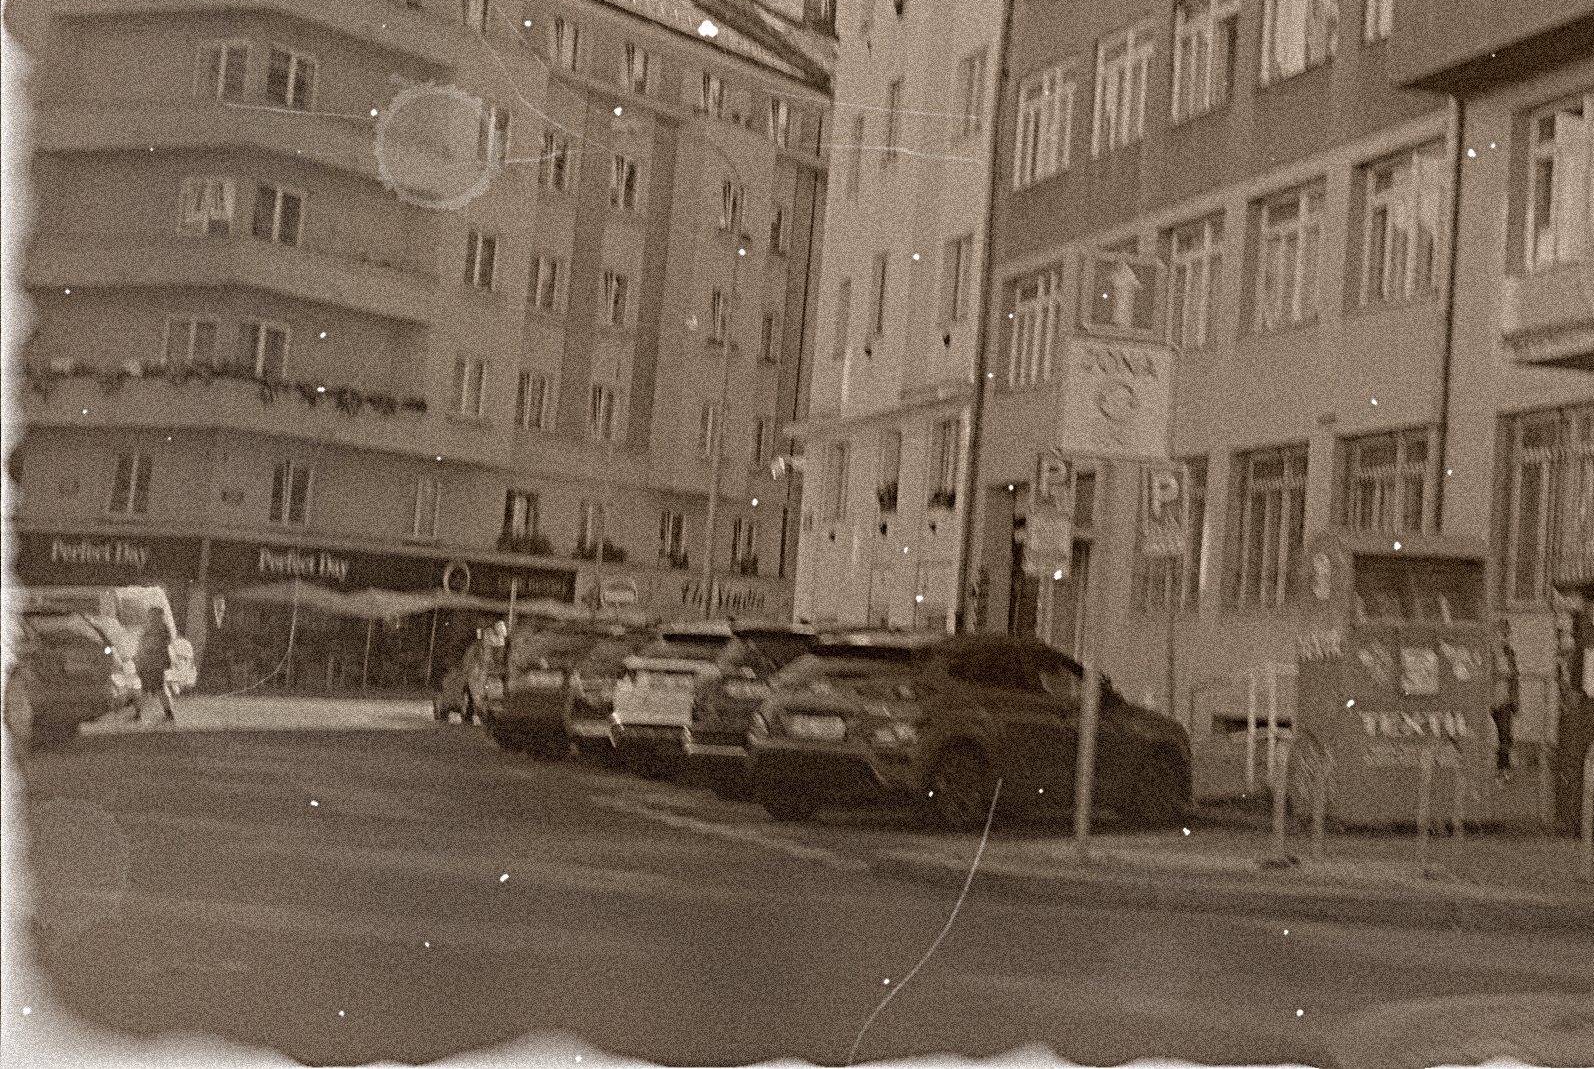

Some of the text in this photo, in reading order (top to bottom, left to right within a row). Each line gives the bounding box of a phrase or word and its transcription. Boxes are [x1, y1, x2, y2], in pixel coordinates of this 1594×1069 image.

[1041, 459, 1068, 499] P
[1151, 468, 1179, 519] P
[1358, 709, 1475, 739] TEXTIL
